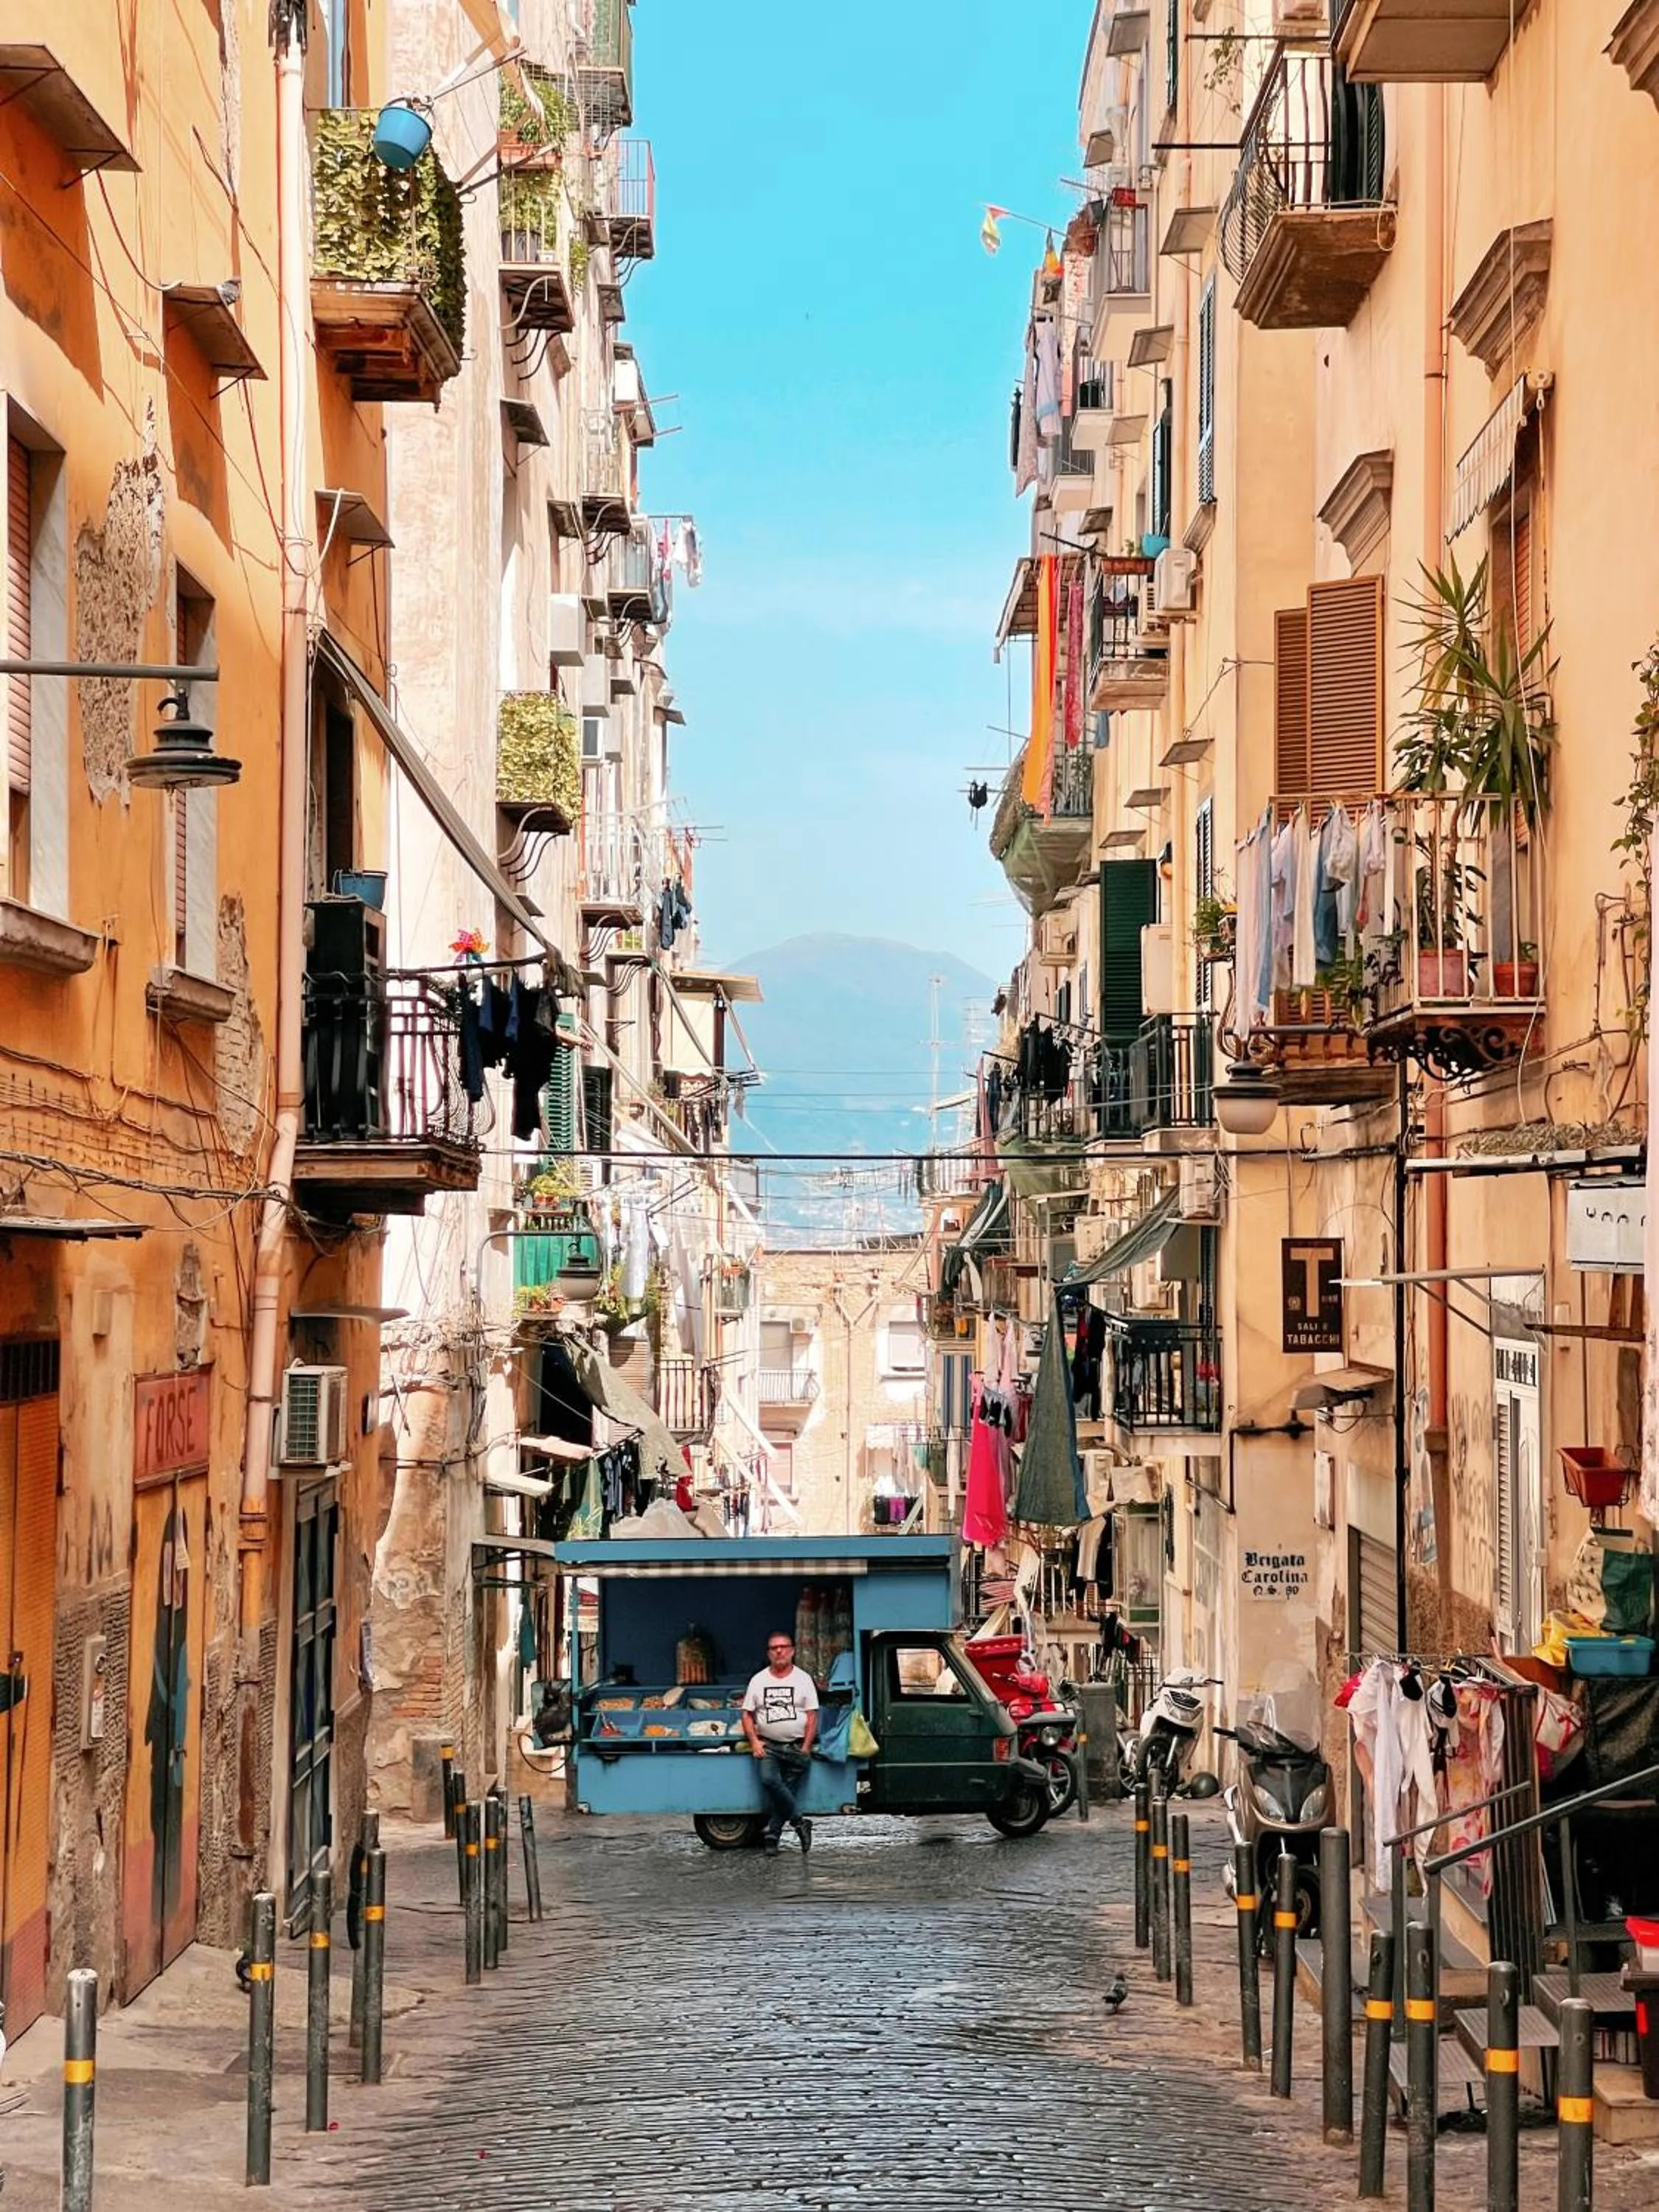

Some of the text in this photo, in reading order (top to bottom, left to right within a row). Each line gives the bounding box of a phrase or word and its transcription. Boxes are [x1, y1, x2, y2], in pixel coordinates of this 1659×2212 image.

[1290, 1248, 1334, 1317] T
[1287, 1335, 1340, 1344] TABACCHI
[145, 1386, 197, 1472] FORSE
[1245, 1552, 1304, 1568] Brigata
[1242, 1570, 1308, 1583] Carolina
